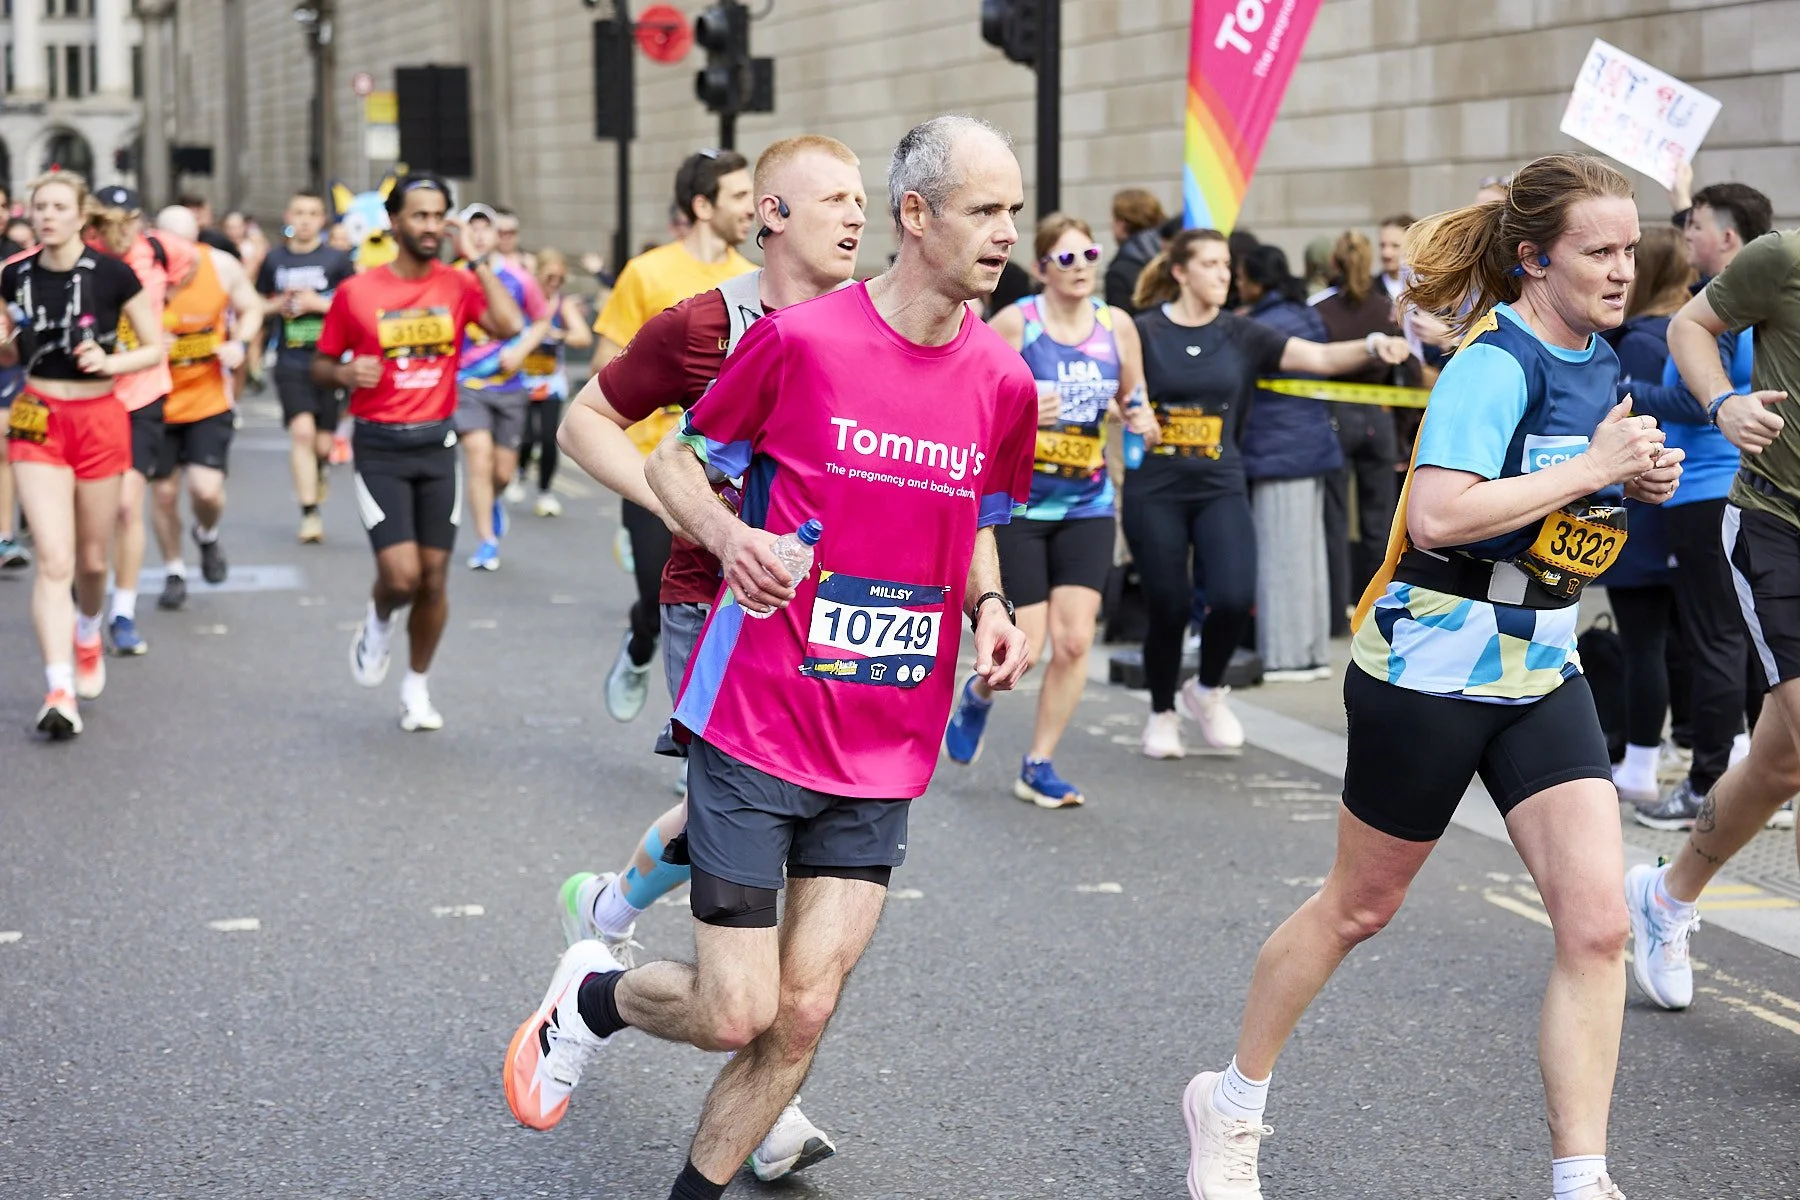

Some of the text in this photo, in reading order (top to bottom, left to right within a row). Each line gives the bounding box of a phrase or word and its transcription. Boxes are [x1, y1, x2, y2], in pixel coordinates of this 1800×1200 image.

[1214, 0, 1272, 55] To
[1057, 360, 1103, 382] LISA
[830, 416, 986, 481] Tommy's
[825, 462, 846, 475] The
[848, 468, 905, 488] pregnancy
[908, 478, 928, 490] and
[930, 480, 955, 497] baby
[1550, 520, 1616, 569] 3323
[869, 585, 913, 600] MILLSY
[823, 607, 932, 650] 10749
